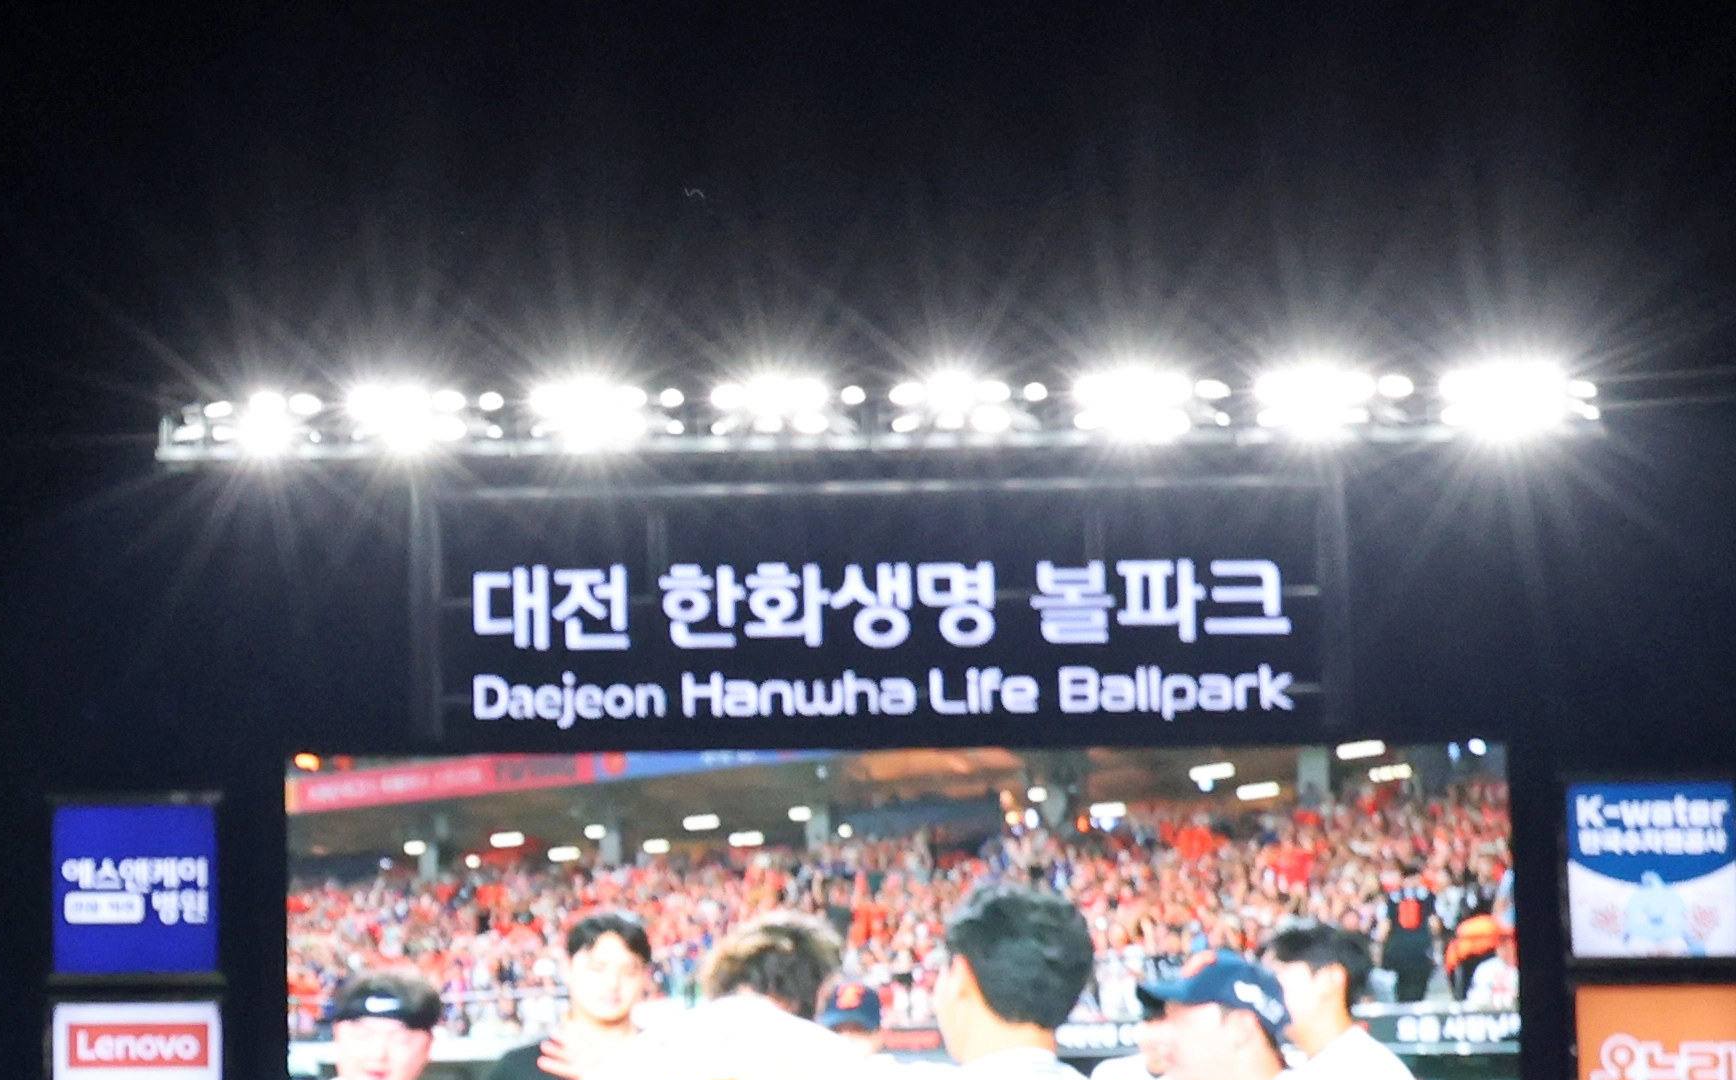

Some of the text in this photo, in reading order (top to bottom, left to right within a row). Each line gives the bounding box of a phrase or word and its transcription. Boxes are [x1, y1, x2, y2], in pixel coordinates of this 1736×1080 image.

[472, 558, 1293, 651] 대전 한화생명 볼파크
[473, 663, 1293, 729] Daejeon Hanwha Life Ballpark
[1576, 794, 1729, 828] K-water
[76, 1030, 200, 1061] Lenovo
